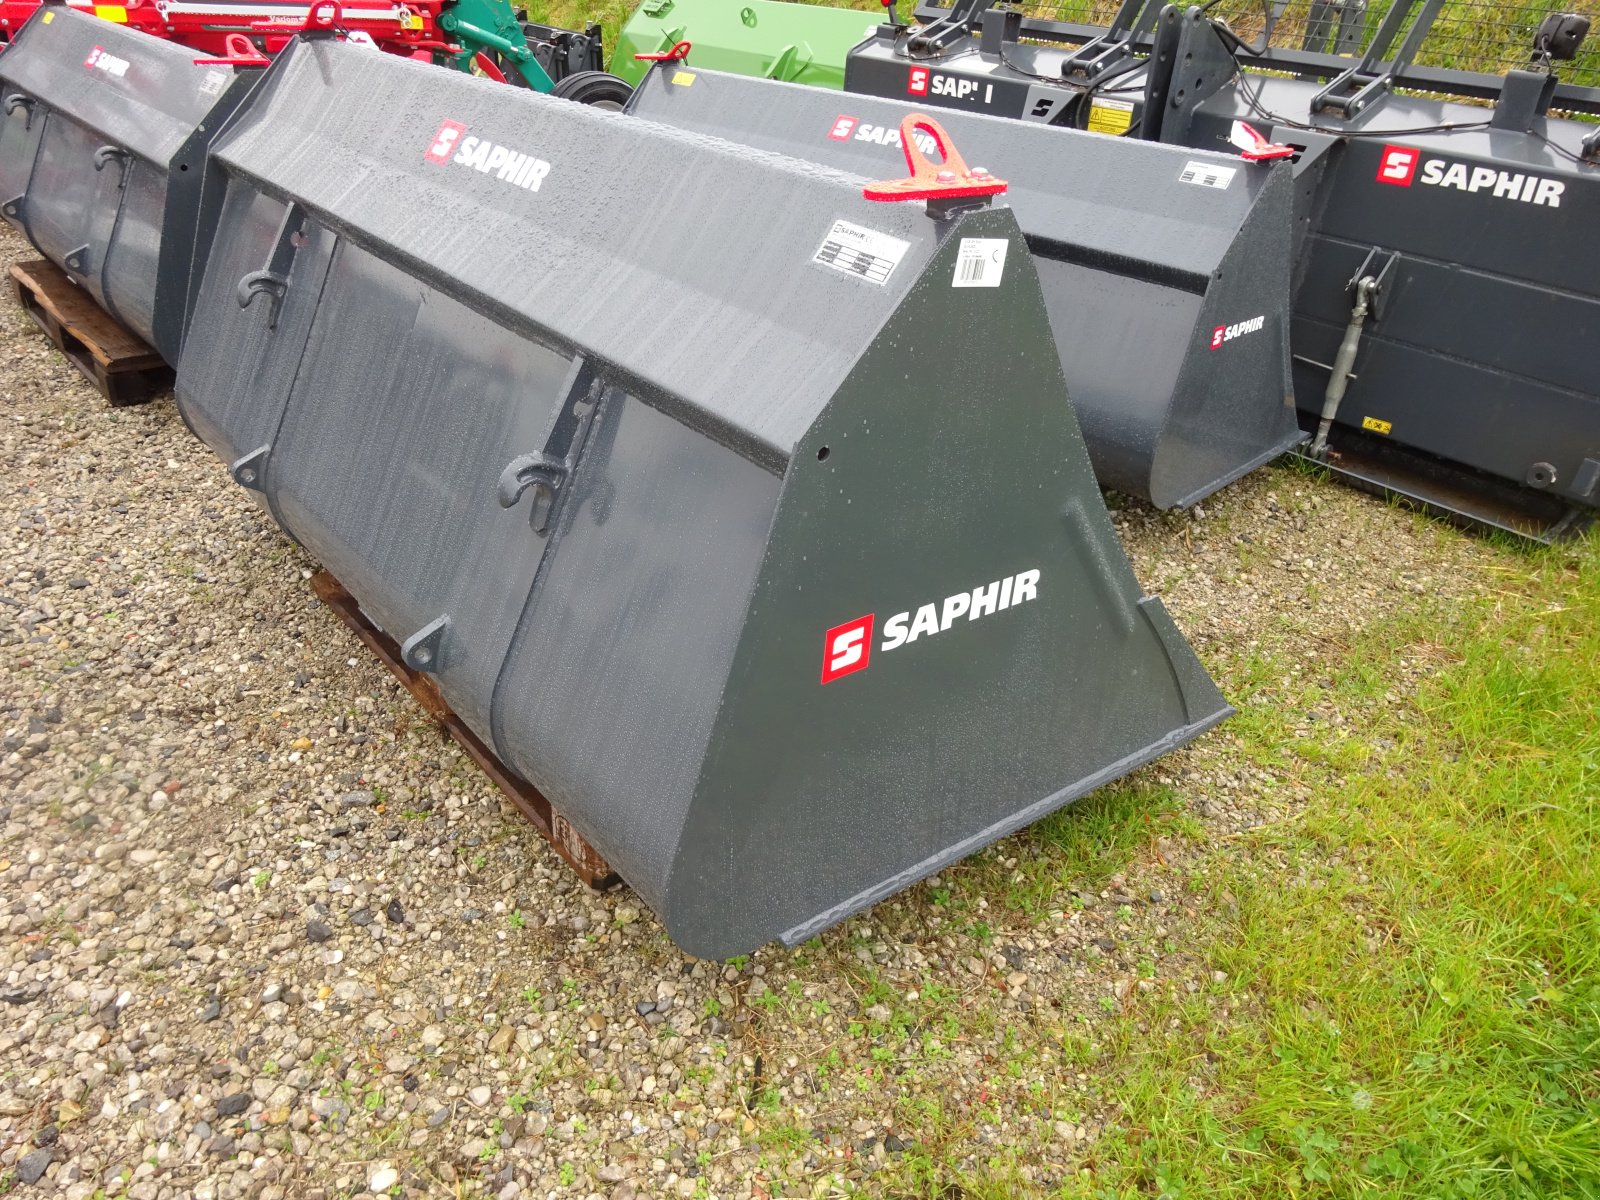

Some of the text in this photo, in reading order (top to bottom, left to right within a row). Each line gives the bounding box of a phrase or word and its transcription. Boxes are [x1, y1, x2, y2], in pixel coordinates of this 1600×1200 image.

[453, 136, 551, 193] SAPHIR
[1420, 159, 1566, 208] SAPHIR
[1223, 315, 1265, 342] SAPHIR
[881, 568, 1041, 652] SAPHIR
